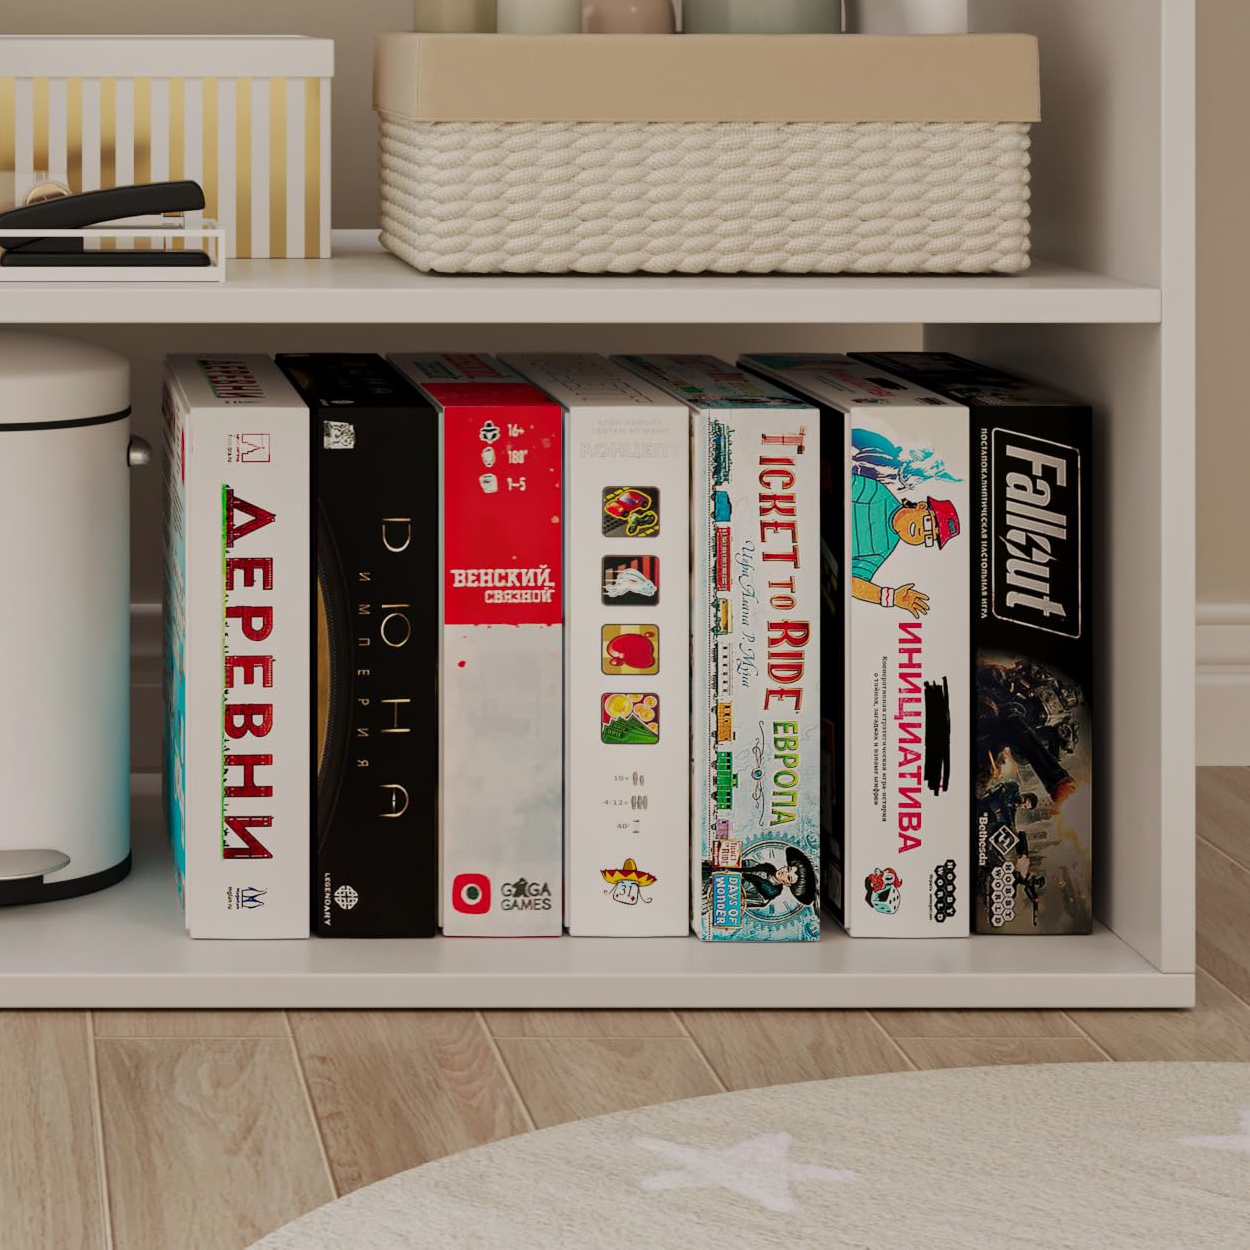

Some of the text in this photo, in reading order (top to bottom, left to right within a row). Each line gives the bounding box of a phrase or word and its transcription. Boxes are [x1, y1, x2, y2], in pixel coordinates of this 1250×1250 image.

[507, 423, 525, 437] 16+
[759, 426, 808, 569] TICKET
[980, 428, 988, 619] ПОСТАПОКАЛИПТИЧЕСКАЯ НАСТОЛЬНАЯ ИГРА
[1003, 444, 1067, 617] Fallout
[450, 564, 555, 588] ВЕНСКИЙ
[734, 540, 756, 578] Игра
[484, 587, 555, 603] СВЯЗНОЙ
[223, 484, 276, 859] ДЕРЕВНИ
[357, 571, 371, 768] ИМПЕРИЯ
[736, 643, 759, 688] Муна
[763, 620, 811, 711] RIDE
[894, 622, 923, 854] ИНИЦИАТИВА
[768, 721, 800, 828] ЕВРОПА
[978, 816, 989, 866] Bethesda
[323, 872, 332, 926] LEGENDARY
[501, 898, 552, 911] GAMES
[715, 877, 726, 924] WONDER
[728, 877, 739, 924] DAYS OF
[936, 866, 945, 922] WORLD
[945, 860, 955, 916] HOBBY
[993, 868, 1003, 925] WORLD
[1003, 863, 1014, 920] HOBBY
